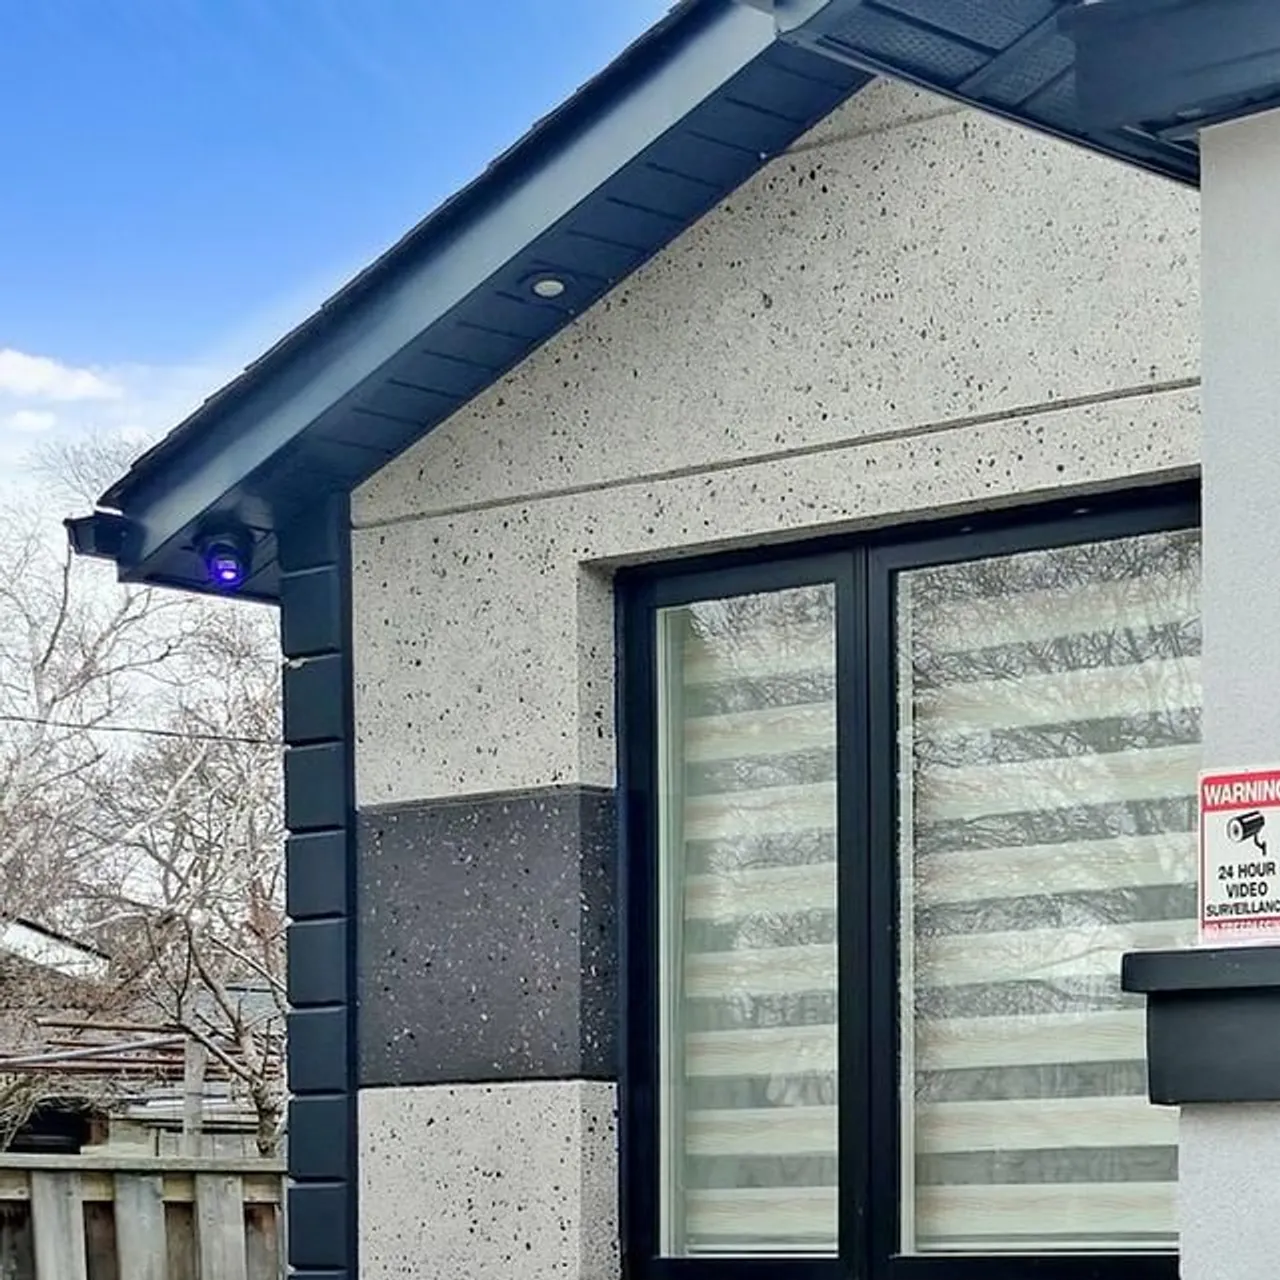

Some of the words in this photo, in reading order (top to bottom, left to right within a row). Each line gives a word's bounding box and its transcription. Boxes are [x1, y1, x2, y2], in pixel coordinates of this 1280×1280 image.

[1218, 865, 1234, 880] 24
[1238, 862, 1276, 878] HOUR
[1226, 882, 1269, 897] VIDEO
